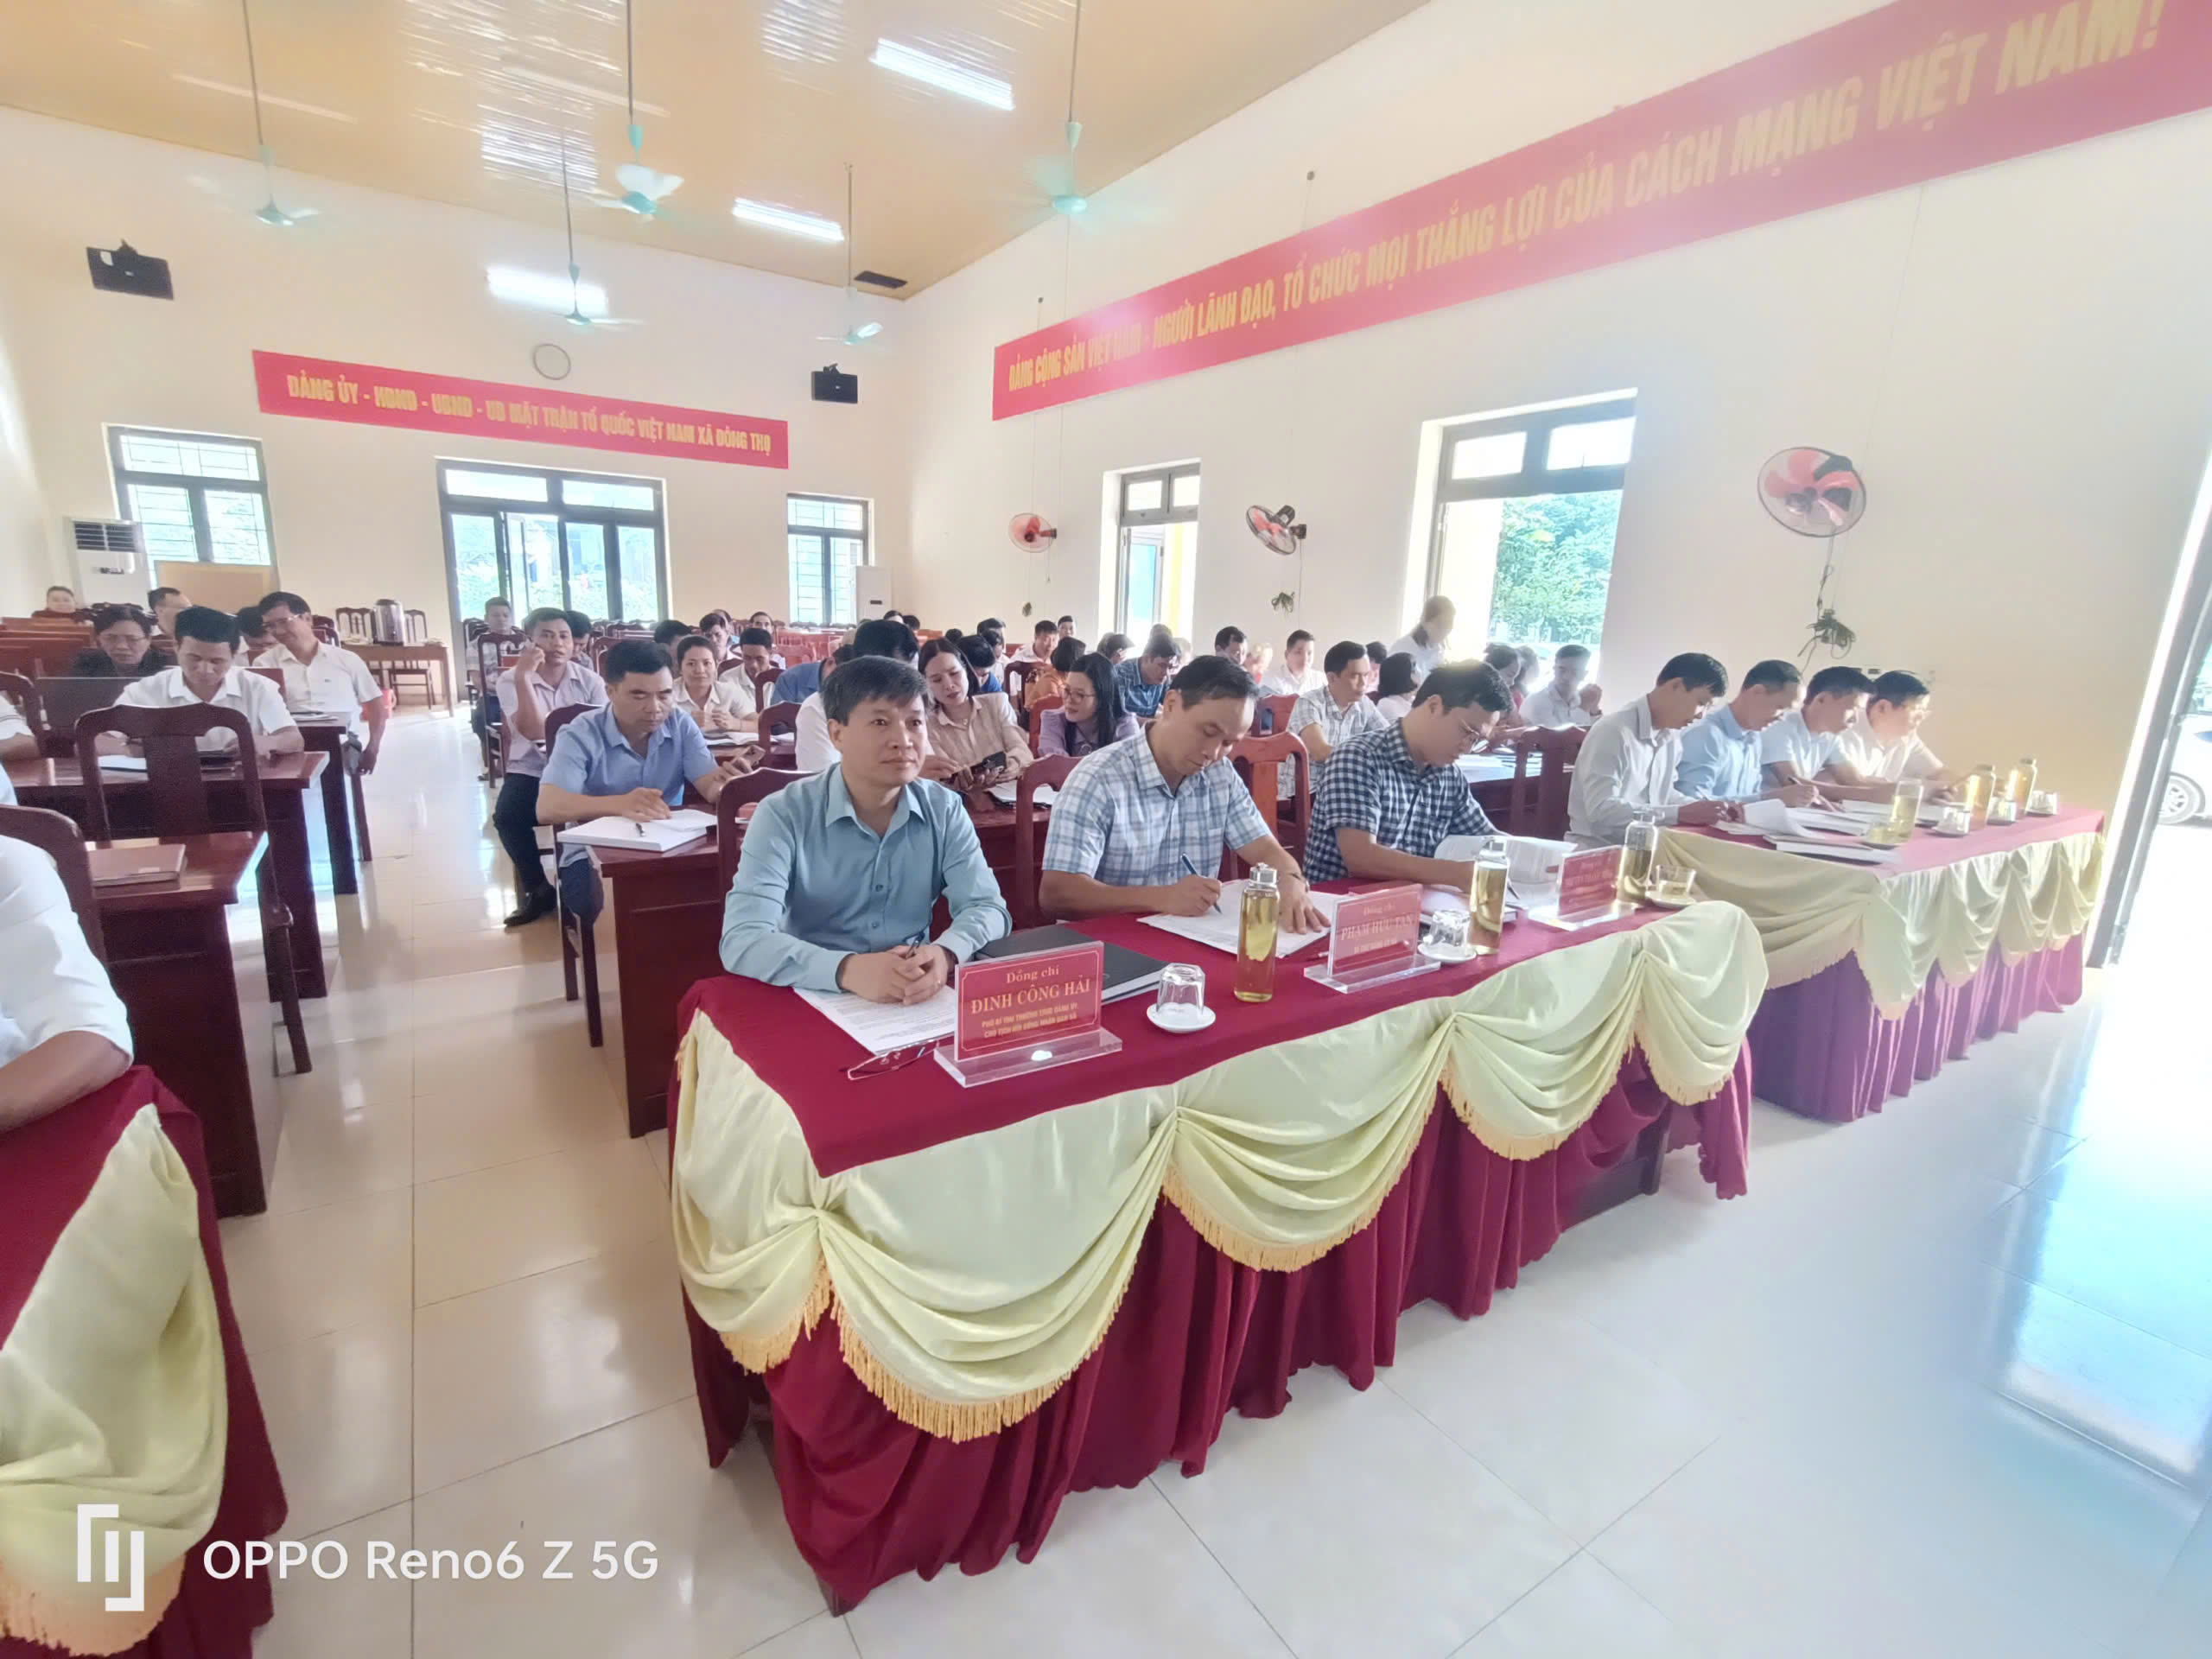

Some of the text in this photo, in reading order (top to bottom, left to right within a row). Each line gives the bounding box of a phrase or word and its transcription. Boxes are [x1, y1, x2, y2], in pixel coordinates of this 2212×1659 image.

[1009, 353, 1033, 392] ĐẢNG
[1035, 347, 1061, 387] CỘNG
[1064, 332, 1085, 376] SẢN
[1154, 297, 1194, 350] NGƯỜI
[1197, 291, 1236, 337] LÃNH
[1240, 279, 1276, 329] ĐẠO,
[1308, 245, 1361, 304] CHỨC
[1366, 235, 1408, 291] MỌI
[1415, 198, 1496, 273] THẮNG
[1501, 183, 1548, 252] LỢI
[1553, 152, 1614, 229] CỦA
[1624, 124, 1723, 207] CÁCH
[1729, 76, 1863, 178] MẠNG
[1875, 29, 1988, 131] VIỆT
[287, 369, 334, 402] ĐẢNG
[338, 374, 359, 404] ỦY
[431, 393, 473, 417] UBND
[509, 401, 539, 429] MẶT
[542, 404, 578, 434] TRẬN
[601, 410, 635, 436] QUỐC
[637, 416, 664, 443] VIỆT
[666, 423, 696, 444] NAM
[697, 423, 714, 447] XÃ
[750, 432, 771, 456] THỌ
[971, 974, 1091, 1014] ĐINH CÔNG HẢI
[1041, 964, 1059, 977] chí
